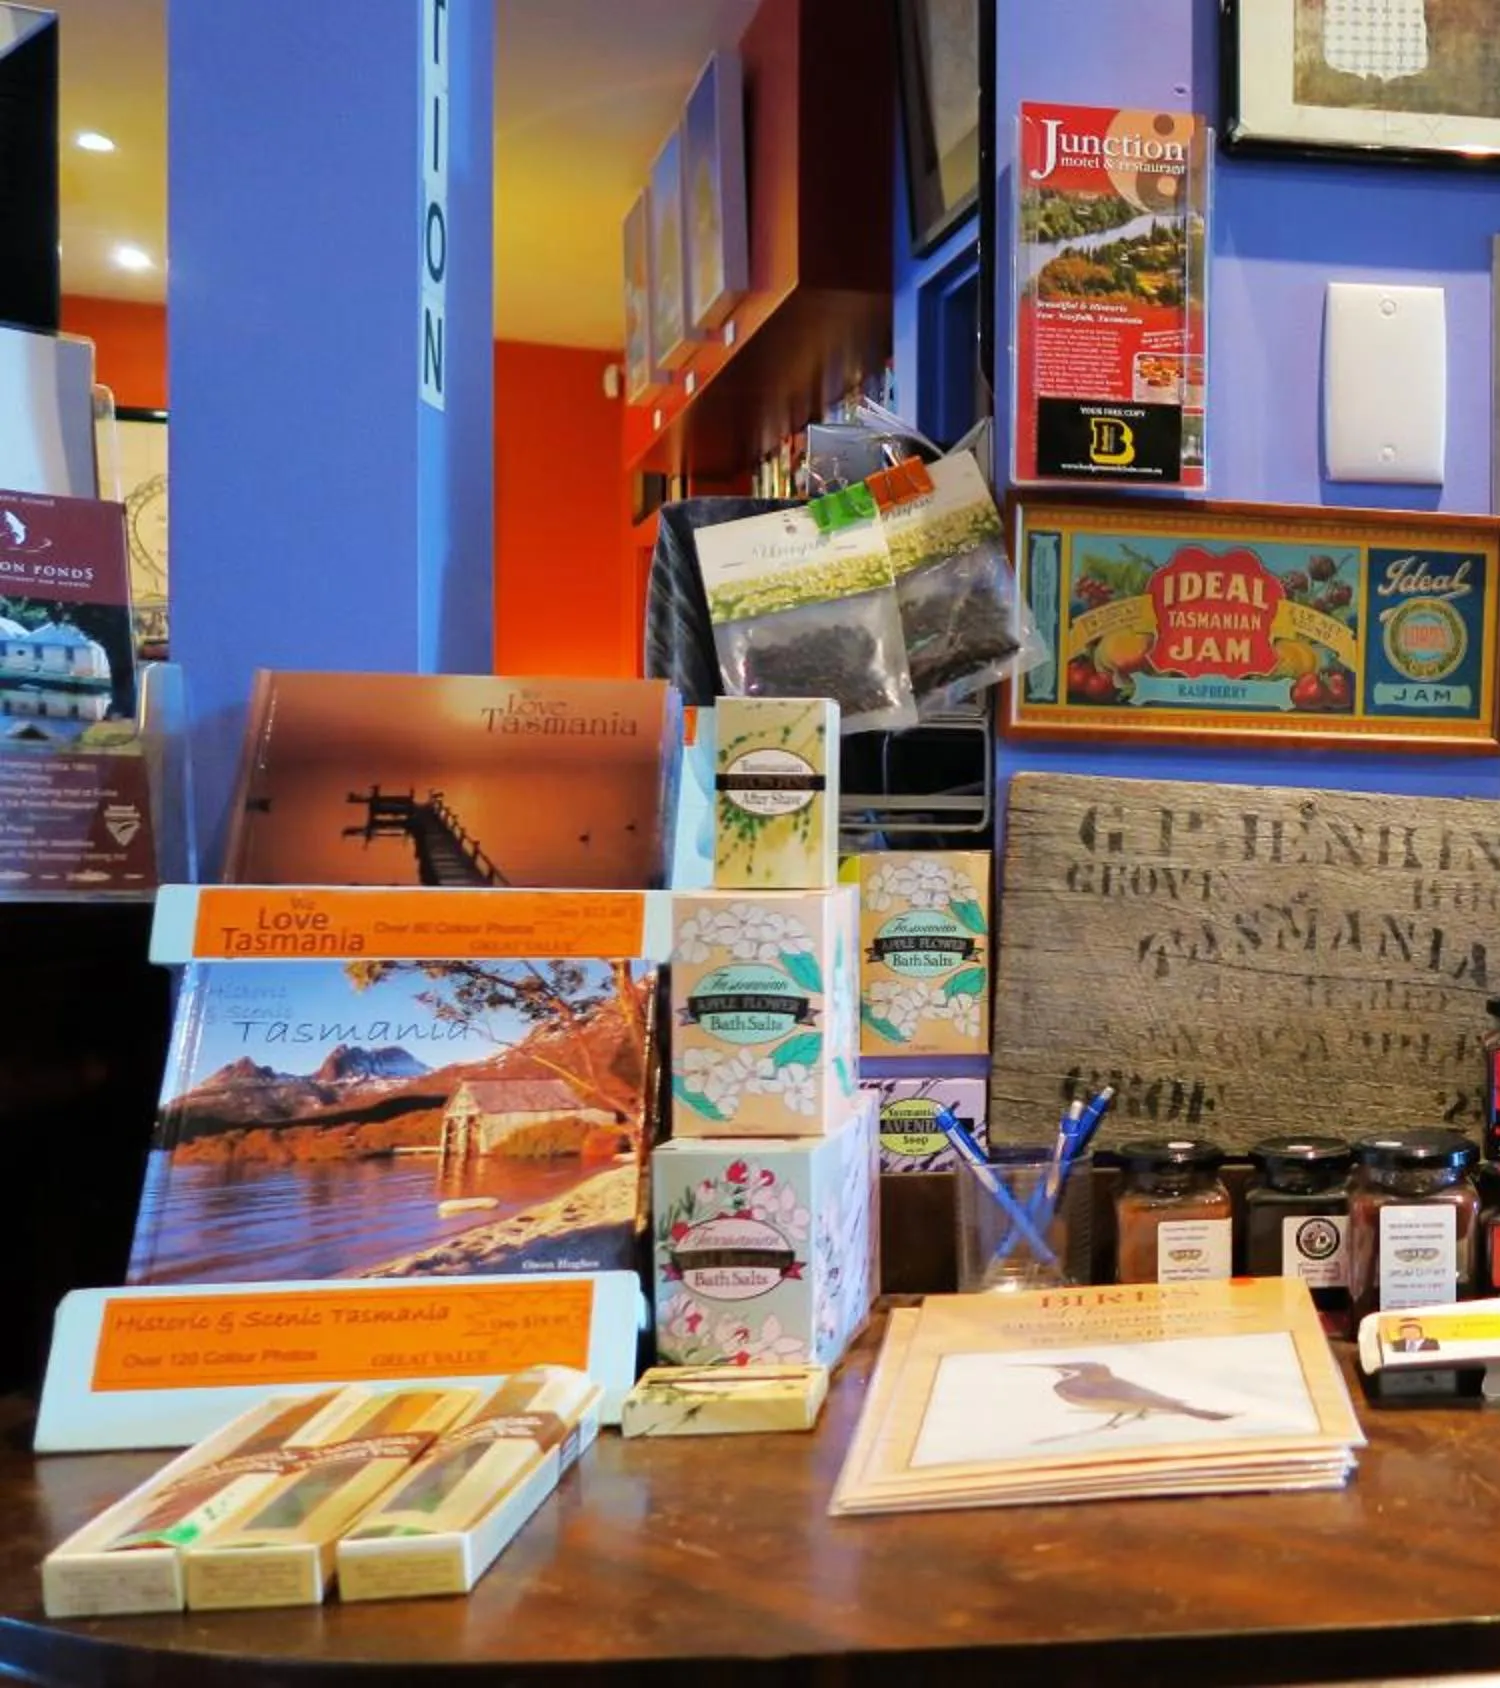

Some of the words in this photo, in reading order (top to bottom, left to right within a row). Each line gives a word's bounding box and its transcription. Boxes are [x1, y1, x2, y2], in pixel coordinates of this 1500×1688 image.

[1029, 119, 1185, 180] Junction
[1061, 156, 1099, 169] motel
[33, 564, 94, 580] PONDS
[1377, 555, 1473, 600] Ideal
[1163, 571, 1269, 610] IDEAL
[1168, 610, 1262, 632] TASMANIAN
[1169, 636, 1251, 664] JAM
[1177, 683, 1249, 699] RASPBERRY
[1393, 687, 1451, 702] JAM
[482, 707, 638, 738] Tasmania
[258, 908, 330, 931] Love
[220, 927, 366, 954] Tasmania
[893, 953, 921, 967] Bath
[922, 953, 953, 967] Salts
[232, 1017, 472, 1044] Tasmania
[710, 1015, 743, 1031] Bath
[747, 1015, 784, 1031] Salts
[694, 1270, 730, 1287] Bath
[731, 1270, 769, 1287] Salts
[115, 1312, 209, 1333] Historic
[240, 1306, 322, 1329] Scenic
[330, 1303, 450, 1325] Tasmania
[121, 1353, 162, 1369] Over
[203, 1350, 256, 1366] Colour
[261, 1348, 318, 1363] Photos
